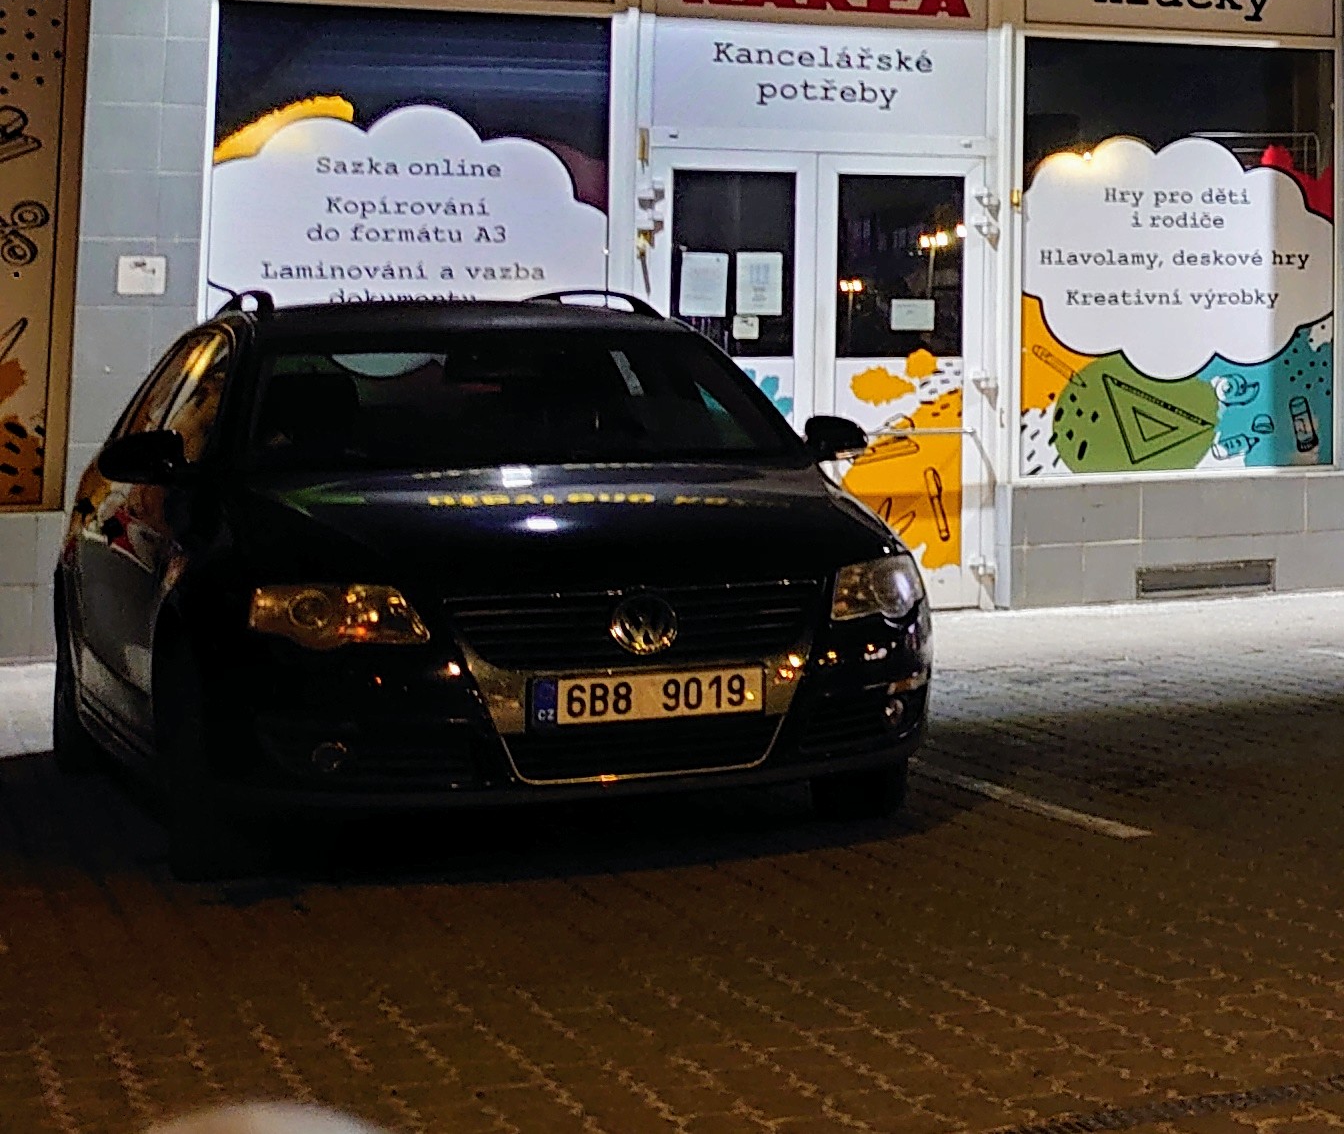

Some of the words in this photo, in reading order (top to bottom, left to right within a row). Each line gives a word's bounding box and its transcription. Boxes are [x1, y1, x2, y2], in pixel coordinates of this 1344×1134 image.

[713, 41, 933, 74] Kancelářské
[756, 81, 899, 110] potřeby
[316, 156, 400, 176] Sazka
[408, 156, 502, 178] online
[325, 196, 491, 219] Kopírování
[1104, 187, 1144, 207] Hry
[1153, 191, 1194, 207] pro
[1201, 187, 1252, 205] děti
[1131, 212, 1142, 228] i
[1149, 212, 1225, 228] rodiče
[307, 224, 341, 242] do
[350, 224, 463, 243] formátu
[474, 226, 507, 243] A3
[1040, 248, 1164, 270] Hlavolamy,
[1172, 249, 1264, 266] deskové
[1271, 250, 1310, 269] hry
[261, 260, 428, 281] Laminování
[440, 265, 455, 280] a
[466, 262, 546, 281] vazba
[1065, 288, 1183, 306] Kreativní
[1190, 289, 1280, 309] výrobky
[566, 681, 633, 718] 6B8
[661, 673, 746, 712] 9019
[537, 709, 555, 721] CZ
